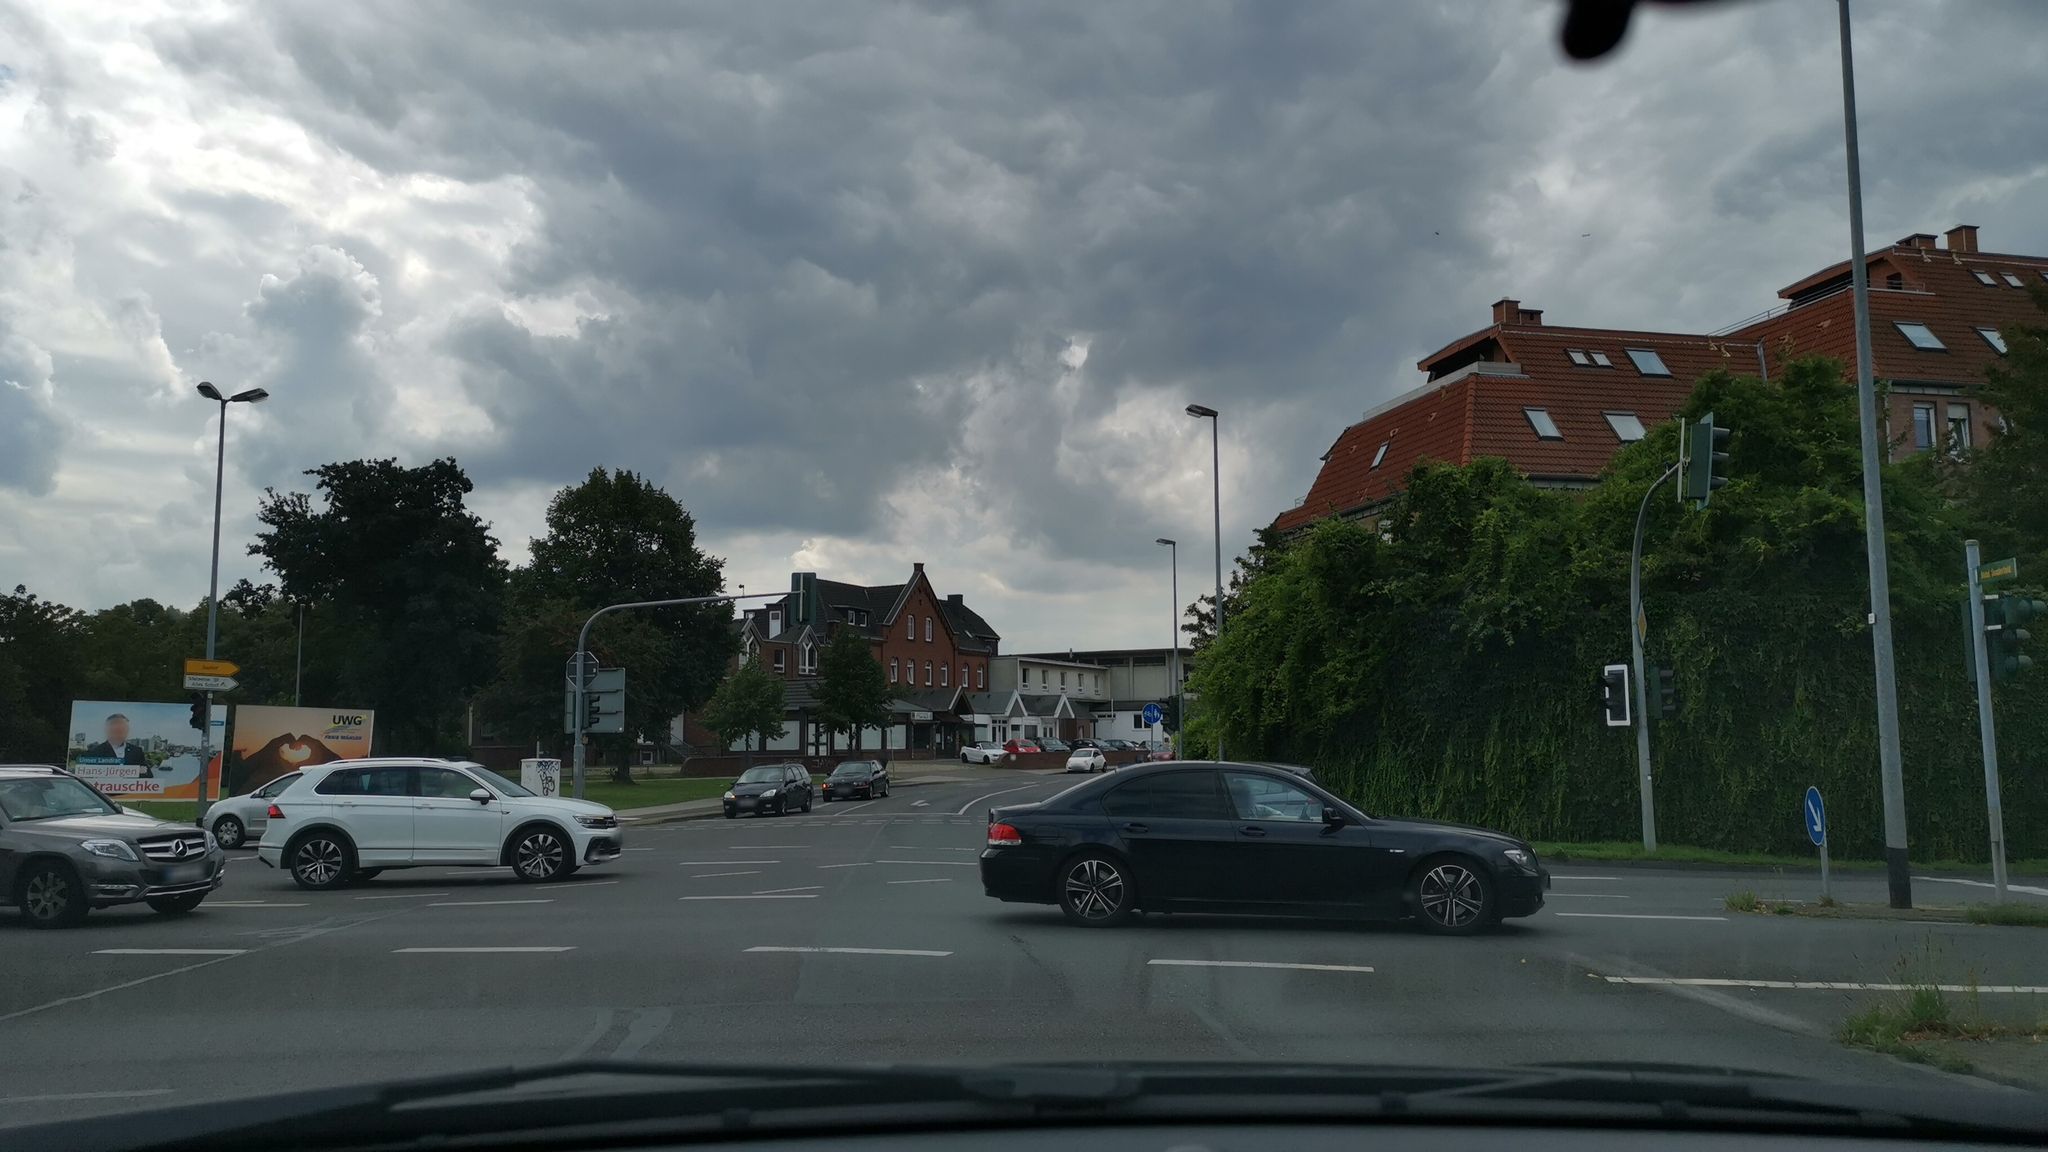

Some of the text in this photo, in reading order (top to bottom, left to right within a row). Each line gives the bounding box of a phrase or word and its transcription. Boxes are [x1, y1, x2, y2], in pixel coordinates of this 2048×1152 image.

[332, 715, 363, 726] UWG
[77, 766, 137, 777] Hans-Jürgen
[94, 780, 160, 792] trauschke
